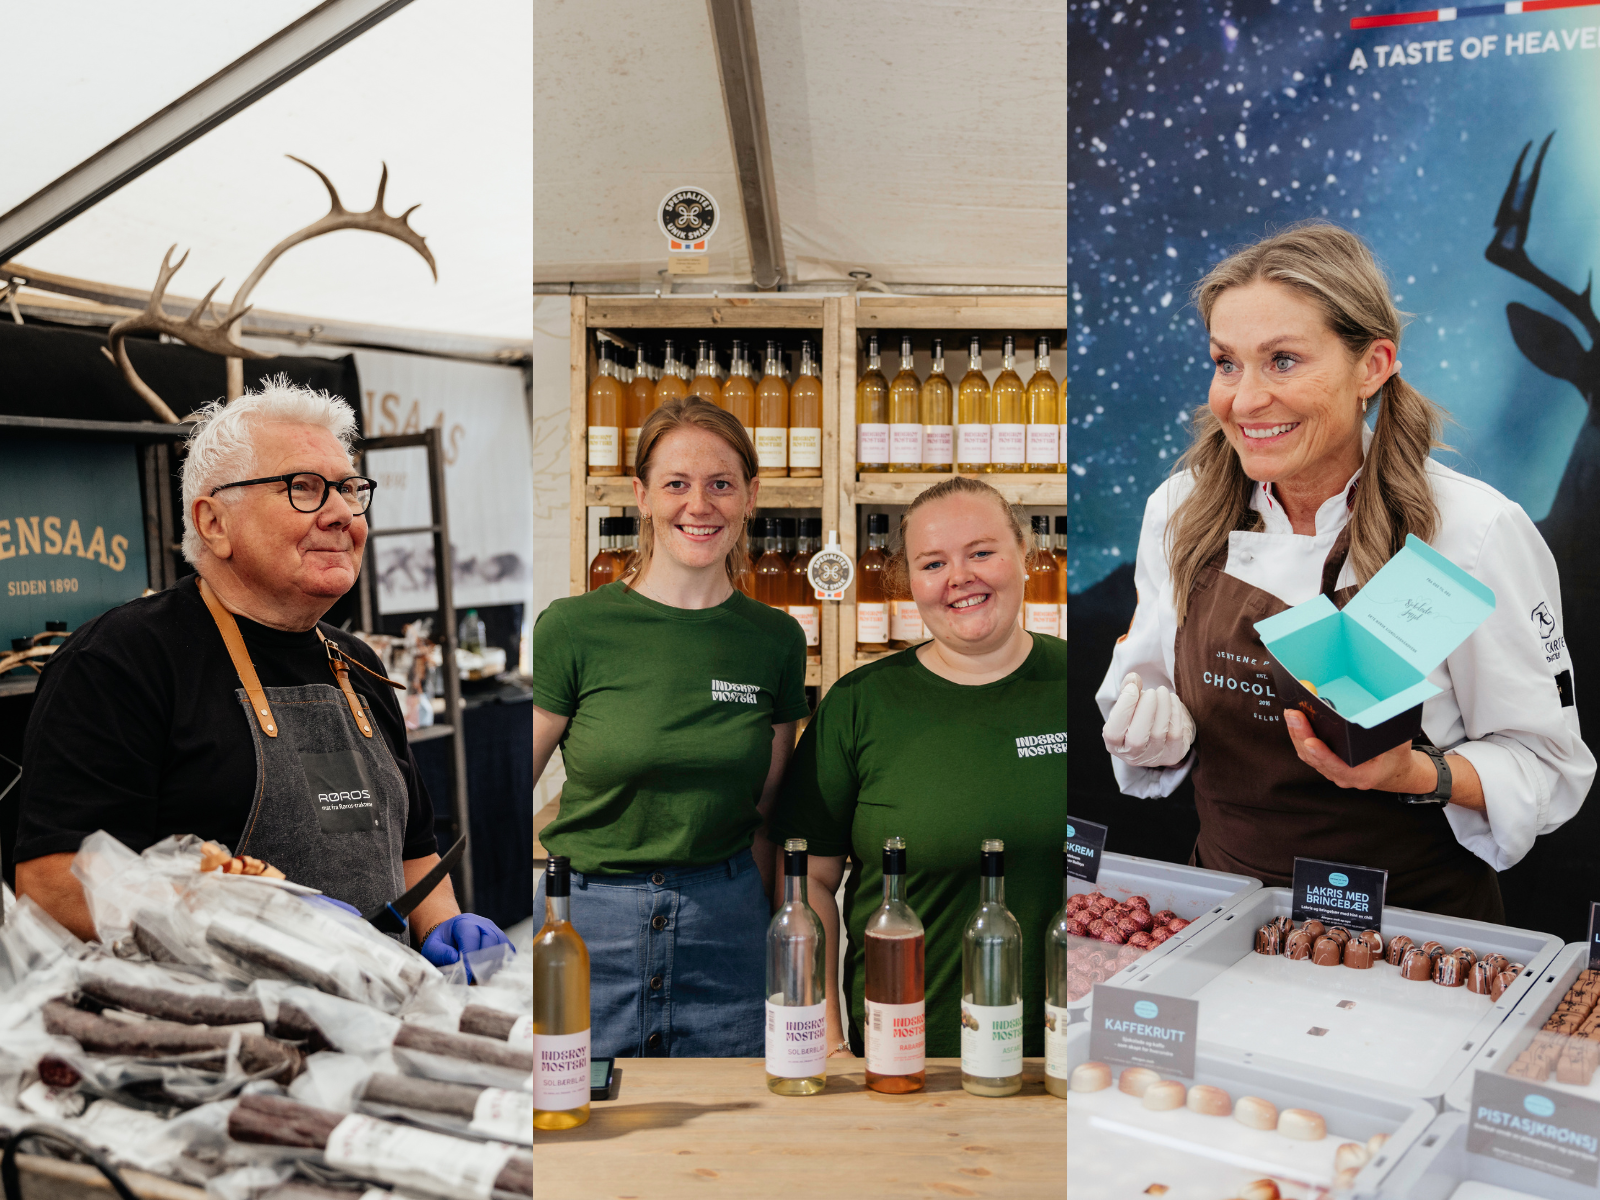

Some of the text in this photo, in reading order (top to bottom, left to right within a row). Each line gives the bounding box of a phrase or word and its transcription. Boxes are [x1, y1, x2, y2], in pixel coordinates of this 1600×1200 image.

[1349, 26, 1600, 71] A TASTE OF HEAVE
[665, 192, 713, 212] SPESIALITET
[667, 223, 711, 240] UNIK SMAK
[8, 578, 79, 596] SIDEN 1890
[1216, 651, 1258, 666] JENTENE
[711, 691, 758, 704] MOSTERI
[318, 789, 371, 803] RØROS
[1306, 884, 1370, 903] LAKRIS MED
[1306, 894, 1369, 912] BRINGEBÆR
[1104, 1018, 1186, 1043] KAFFEKRUTT
[541, 1057, 587, 1072] MOSTERI
